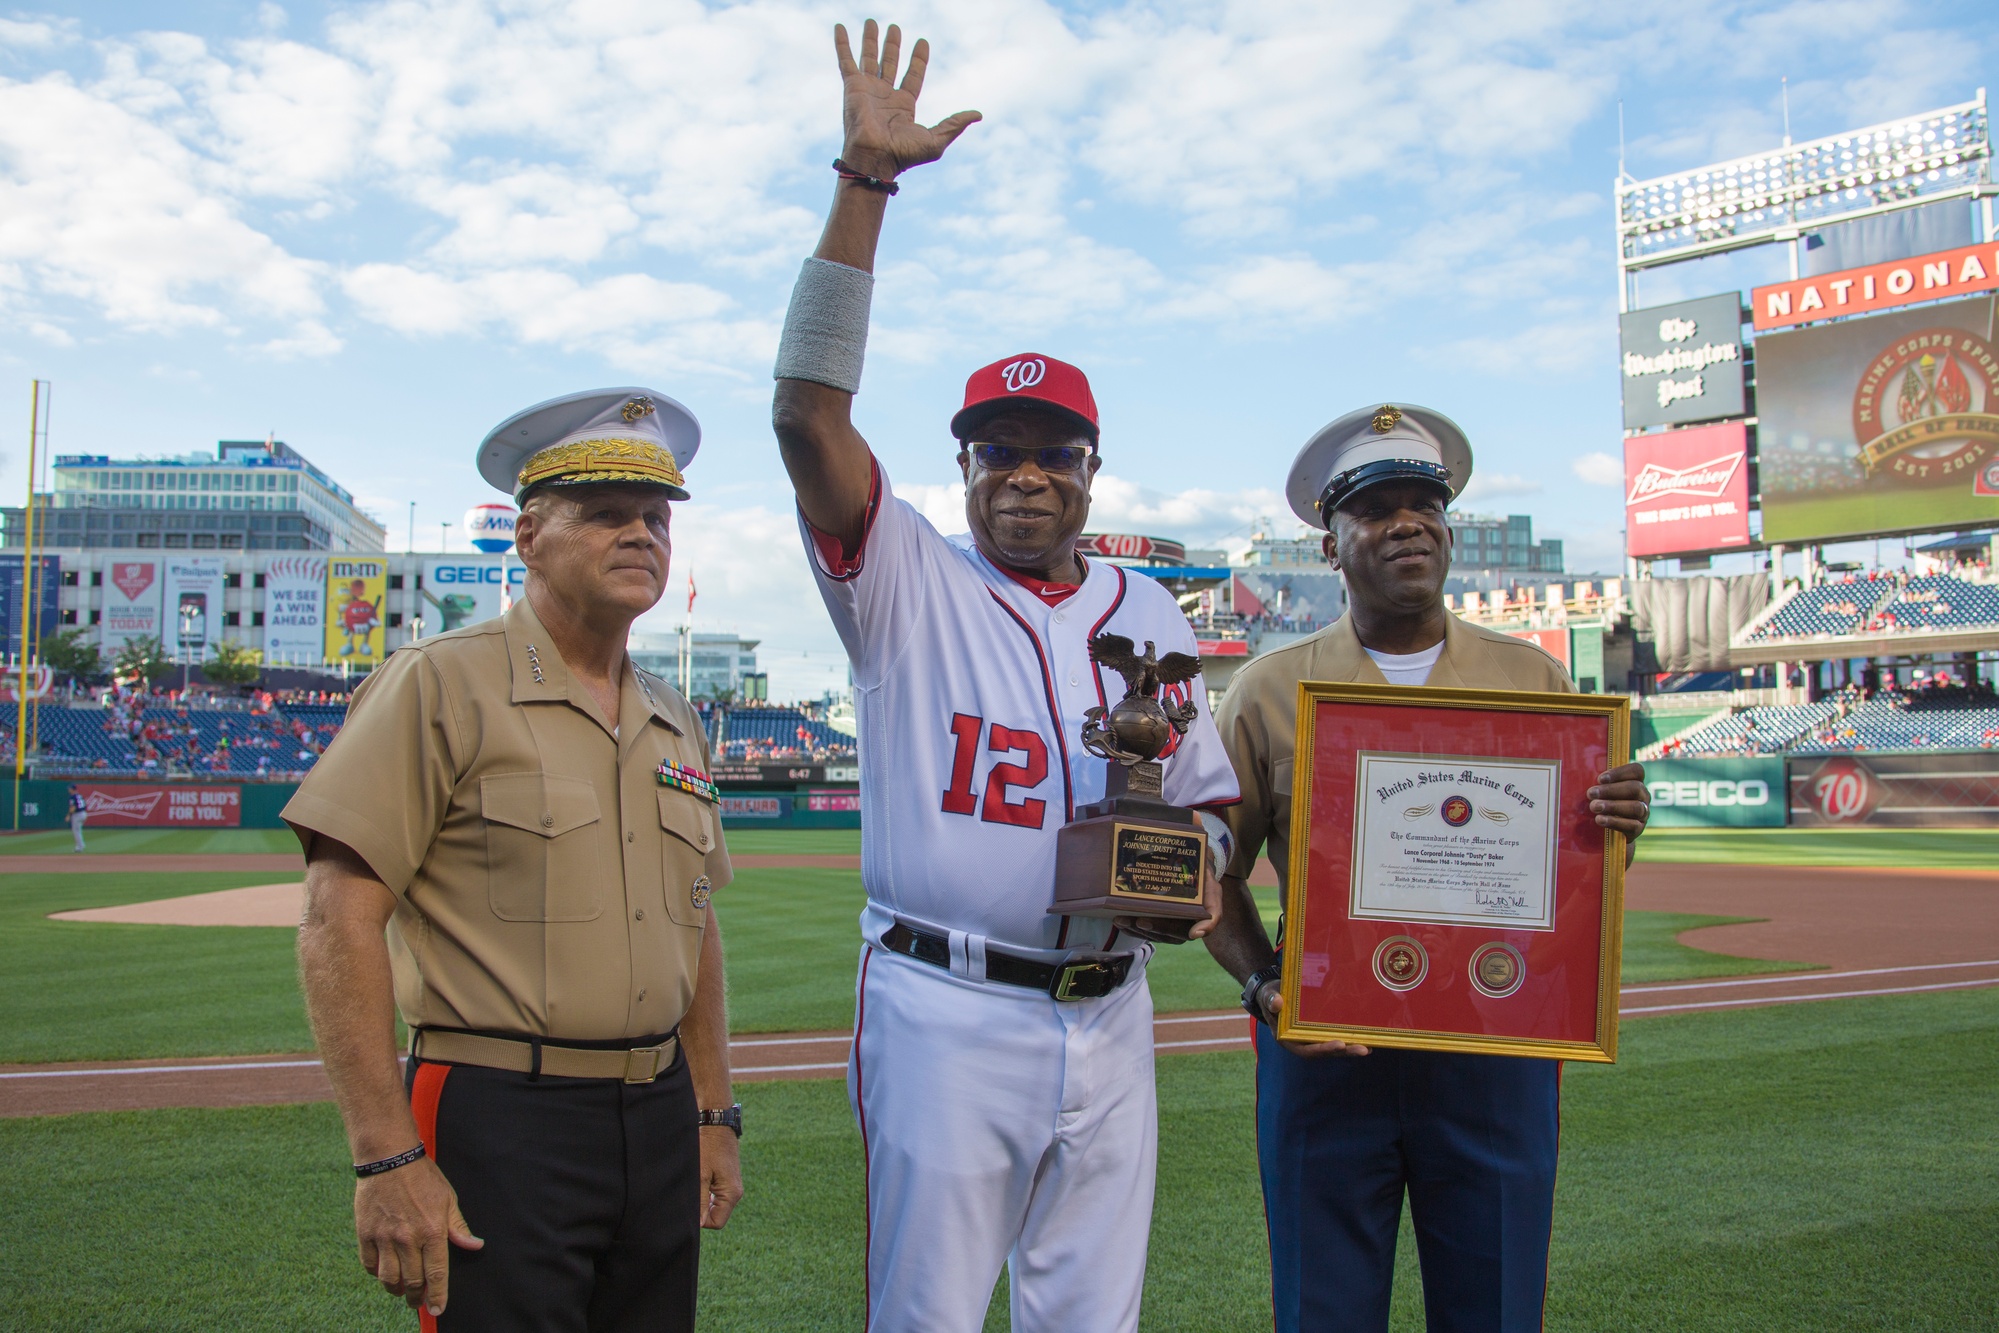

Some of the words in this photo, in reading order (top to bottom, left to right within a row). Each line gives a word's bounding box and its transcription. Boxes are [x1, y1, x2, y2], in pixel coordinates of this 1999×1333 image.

[1767, 249, 1999, 318] NATIONA
[1659, 317, 1696, 343] The
[1623, 342, 1738, 377] Washington
[1001, 358, 1047, 392] W
[1860, 354, 1895, 422] MARINE
[1897, 334, 1953, 356] CORPS
[1657, 374, 1705, 408] Post
[1874, 429, 1916, 454] HALL
[1925, 421, 1947, 434] OF
[1894, 458, 1929, 477] EST
[1942, 444, 1985, 474] 2001
[1634, 468, 1731, 494] Budweiser
[1635, 510, 1658, 525] THIS
[1659, 506, 1691, 522] BUD'S
[1690, 504, 1712, 518] FOR
[1712, 501, 1738, 516] YOU.
[272, 590, 293, 600] WE
[296, 590, 317, 601] SEE
[274, 603, 283, 613] A
[288, 603, 315, 613] WIN
[109, 619, 153, 630] TODAY
[271, 615, 318, 626] AHEAD
[788, 768, 811, 779] 6:47
[941, 712, 1048, 829] 12
[169, 790, 199, 805] THIS
[200, 790, 238, 805] BUD'S
[1376, 777, 1414, 804] United
[1417, 770, 1455, 788] States
[1457, 769, 1501, 790] Marine
[1503, 782, 1535, 809] Corps
[1646, 780, 1769, 807] GEICO
[1815, 767, 1868, 821] W
[169, 806, 195, 820] FOR
[196, 806, 226, 820] YOU.
[1134, 833, 1155, 843] LANCE
[1154, 836, 1187, 847] CORPORAL
[1390, 831, 1403, 841] The
[1405, 832, 1448, 842] Commandant
[1459, 836, 1470, 845] the
[1471, 836, 1496, 846] Marine
[1498, 838, 1520, 848] Corps
[1122, 841, 1150, 851] JOHNNIE
[1151, 844, 1177, 854] "DUSTY"
[1177, 848, 1197, 857] BAKER
[1420, 849, 1443, 857] Corporal
[1123, 866, 1142, 874] UNITED
[1141, 868, 1159, 876] STATES
[1159, 870, 1178, 878] MARINE
[1135, 861, 1160, 870] INDUCTED
[1160, 863, 1173, 871] INTO
[1150, 884, 1160, 892] July
[1170, 877, 1184, 885] FAME
